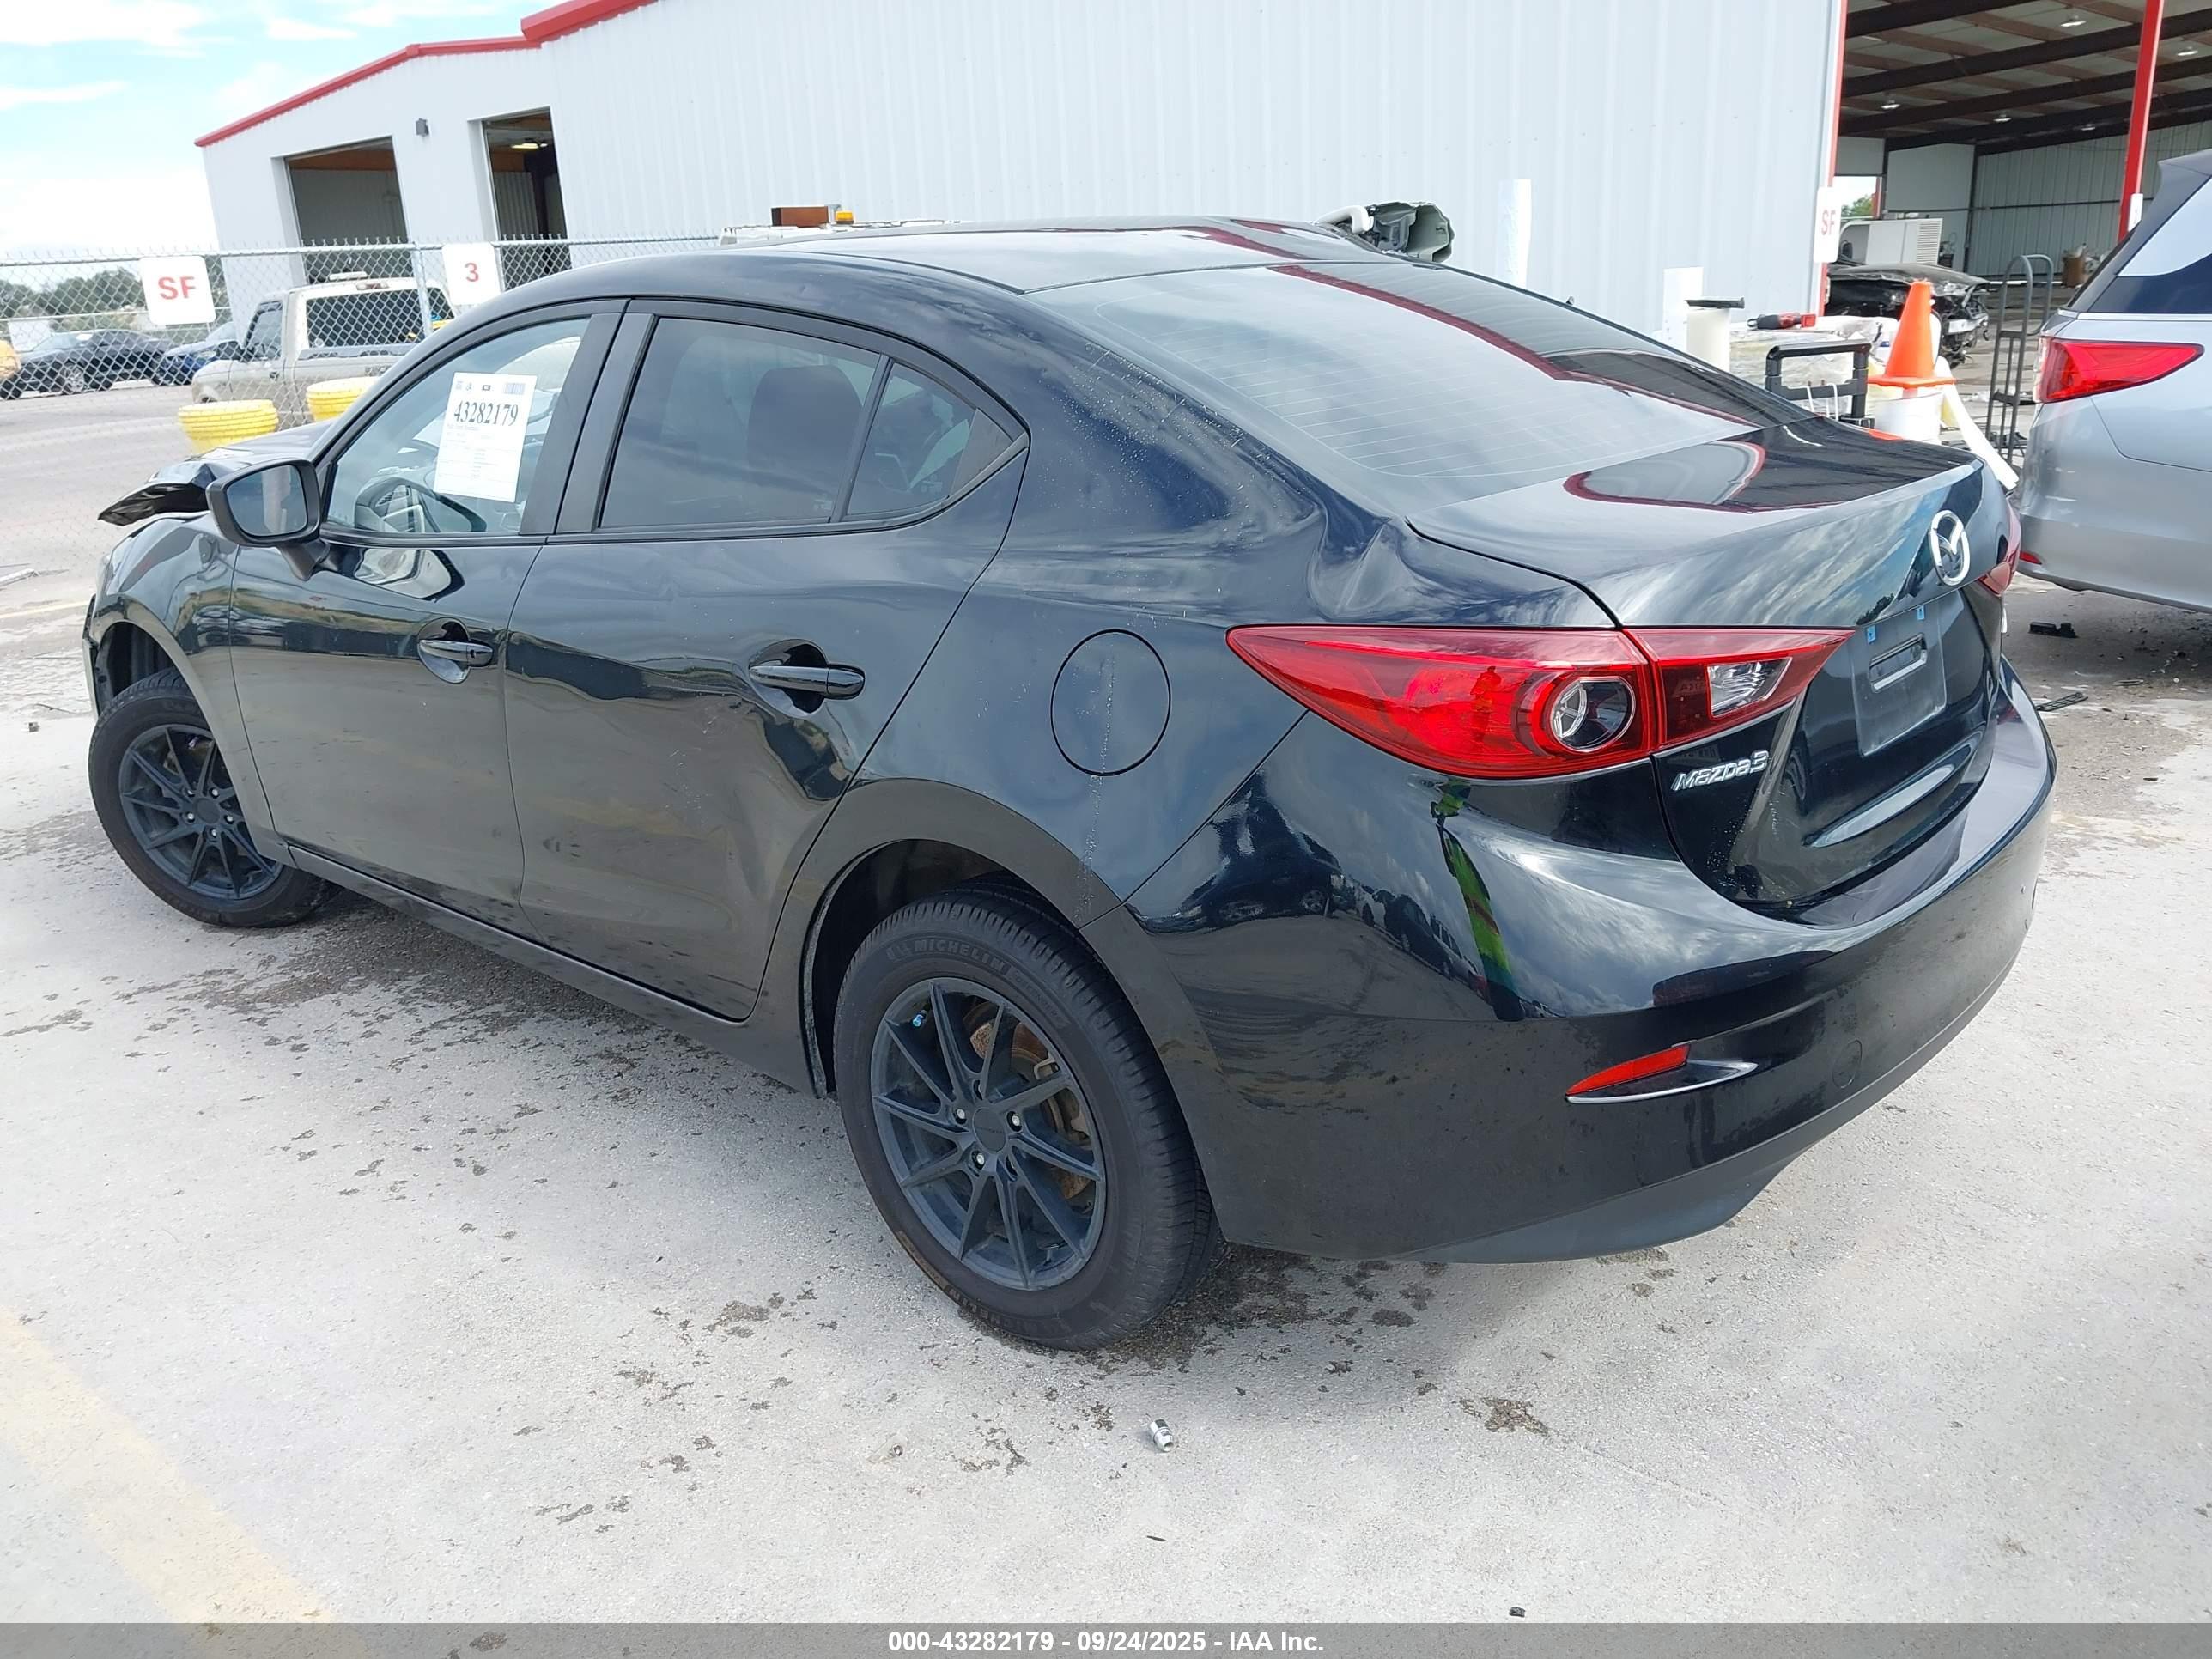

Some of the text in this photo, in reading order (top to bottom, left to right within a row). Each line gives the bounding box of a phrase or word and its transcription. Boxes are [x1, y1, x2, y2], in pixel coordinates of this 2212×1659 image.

[1821, 210, 1836, 236] SF
[465, 262, 479, 283] 3
[158, 276, 196, 300] SF
[453, 400, 519, 426] 43282179
